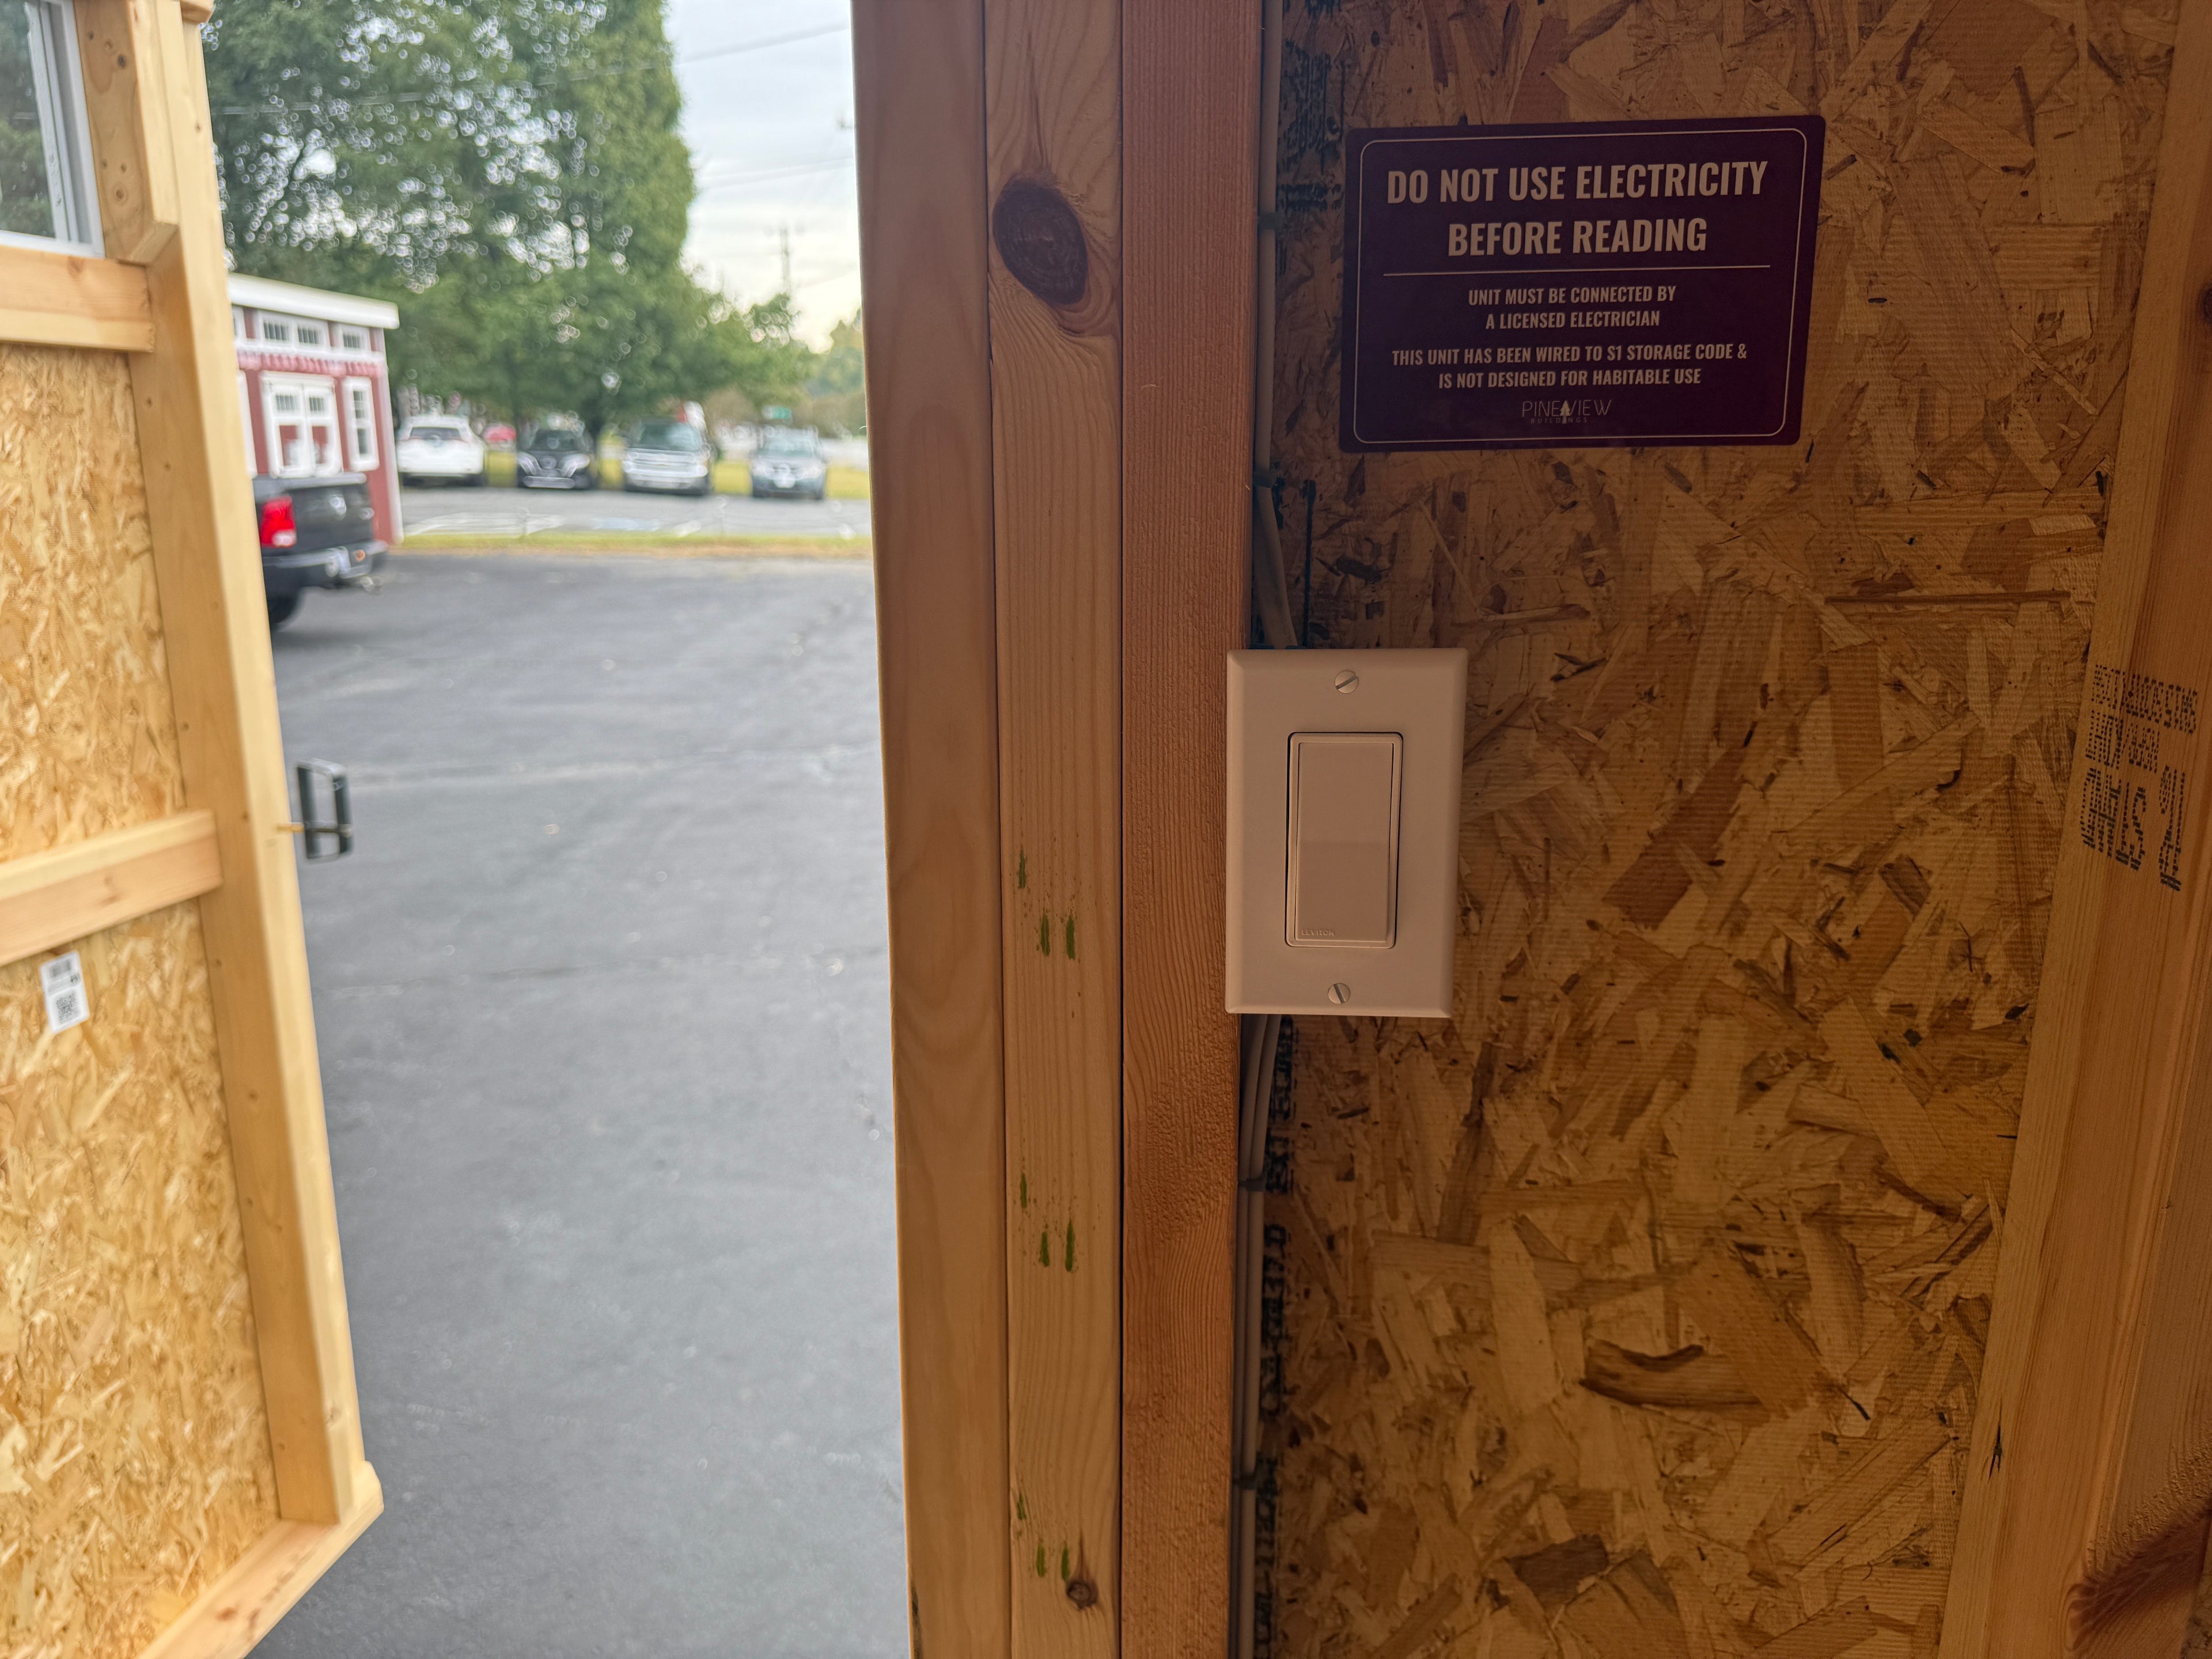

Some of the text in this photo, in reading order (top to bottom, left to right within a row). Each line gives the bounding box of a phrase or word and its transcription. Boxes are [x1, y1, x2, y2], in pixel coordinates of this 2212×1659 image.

[1387, 161, 1769, 204] DO NOT USE ELECTRICITY
[1448, 217, 1707, 257] BEFORE READING
[1468, 286, 1677, 306] UNIT MUST BE CONNECTED BY
[1485, 310, 1660, 330] A LICENSED ELECTRICIAN
[1392, 343, 1748, 366] THIS UNIT HAS BEEN WIRED TO S1 STORAGE CODE &
[1438, 368, 1702, 389] IS NOT DESIGNED FOR HABITABLE USE
[1521, 399, 1612, 418] PINEVIEW
[1301, 929, 1335, 937] LEVITON
